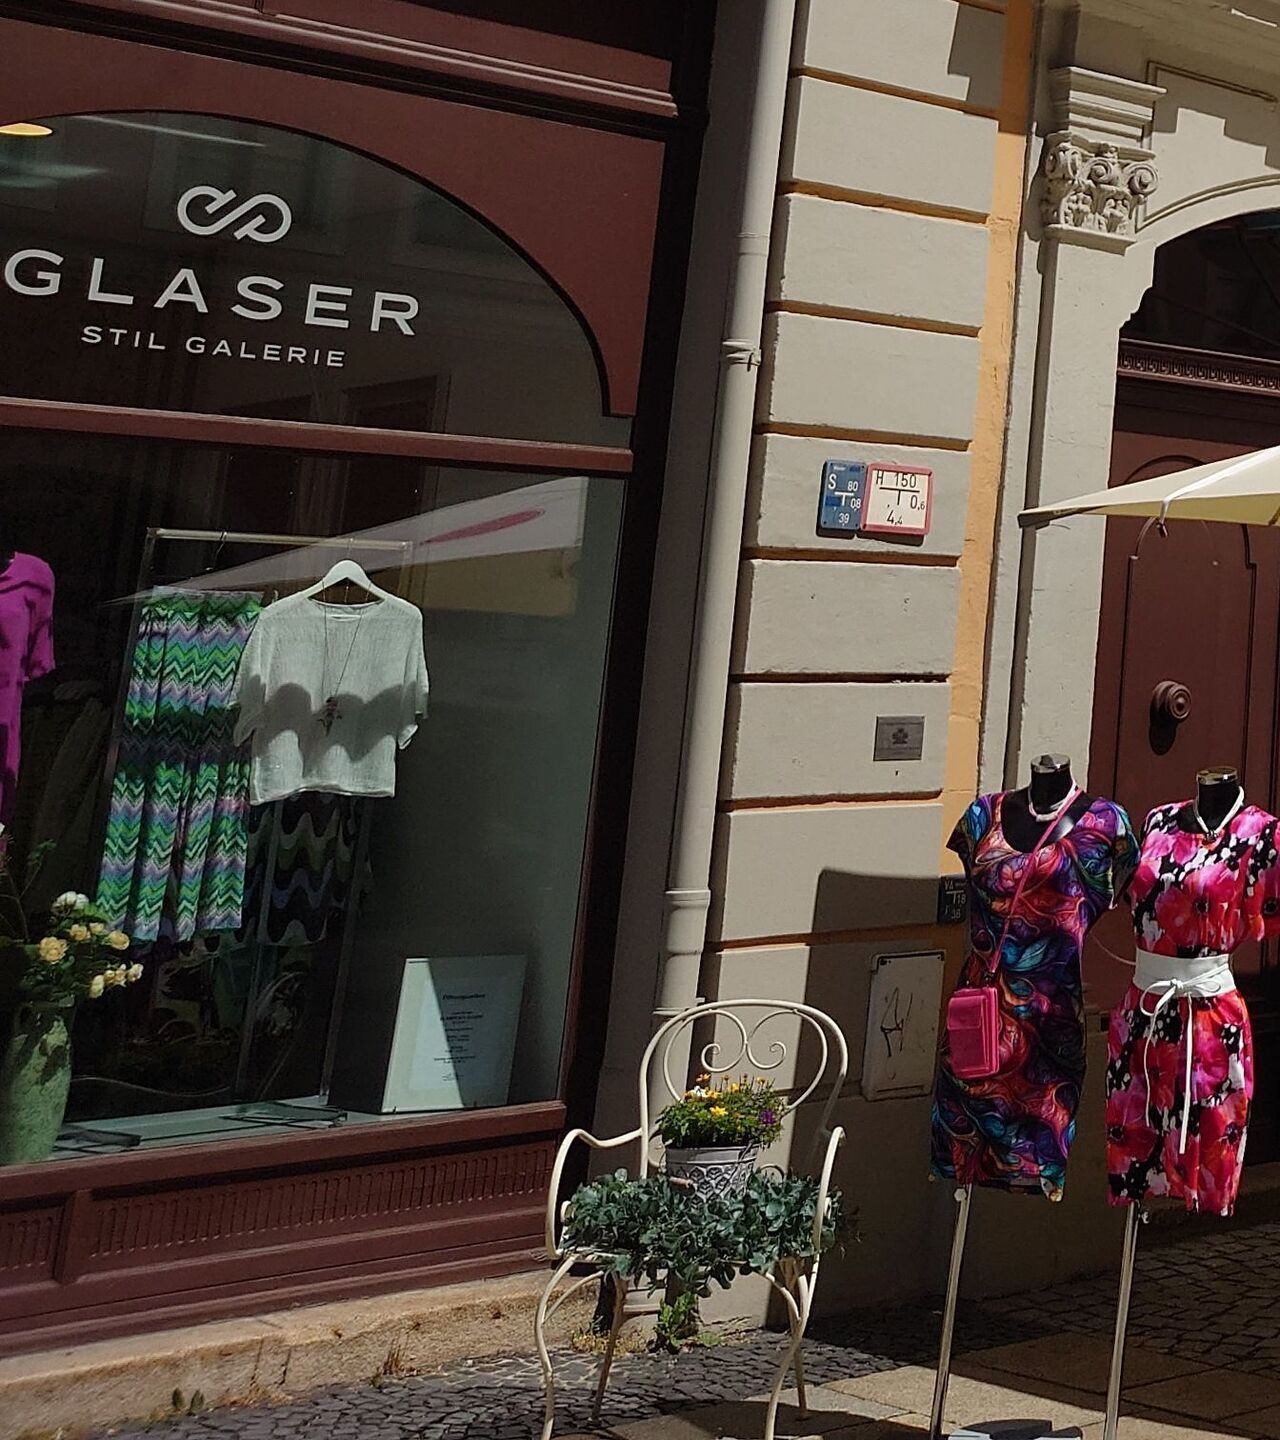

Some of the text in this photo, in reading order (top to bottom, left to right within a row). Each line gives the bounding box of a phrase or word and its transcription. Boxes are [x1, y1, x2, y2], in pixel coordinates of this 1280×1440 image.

[4, 248, 419, 335] GLASER
[81, 326, 345, 368] STIL GALERIE
[828, 473, 859, 492] S 80
[875, 469, 917, 489] H 150
